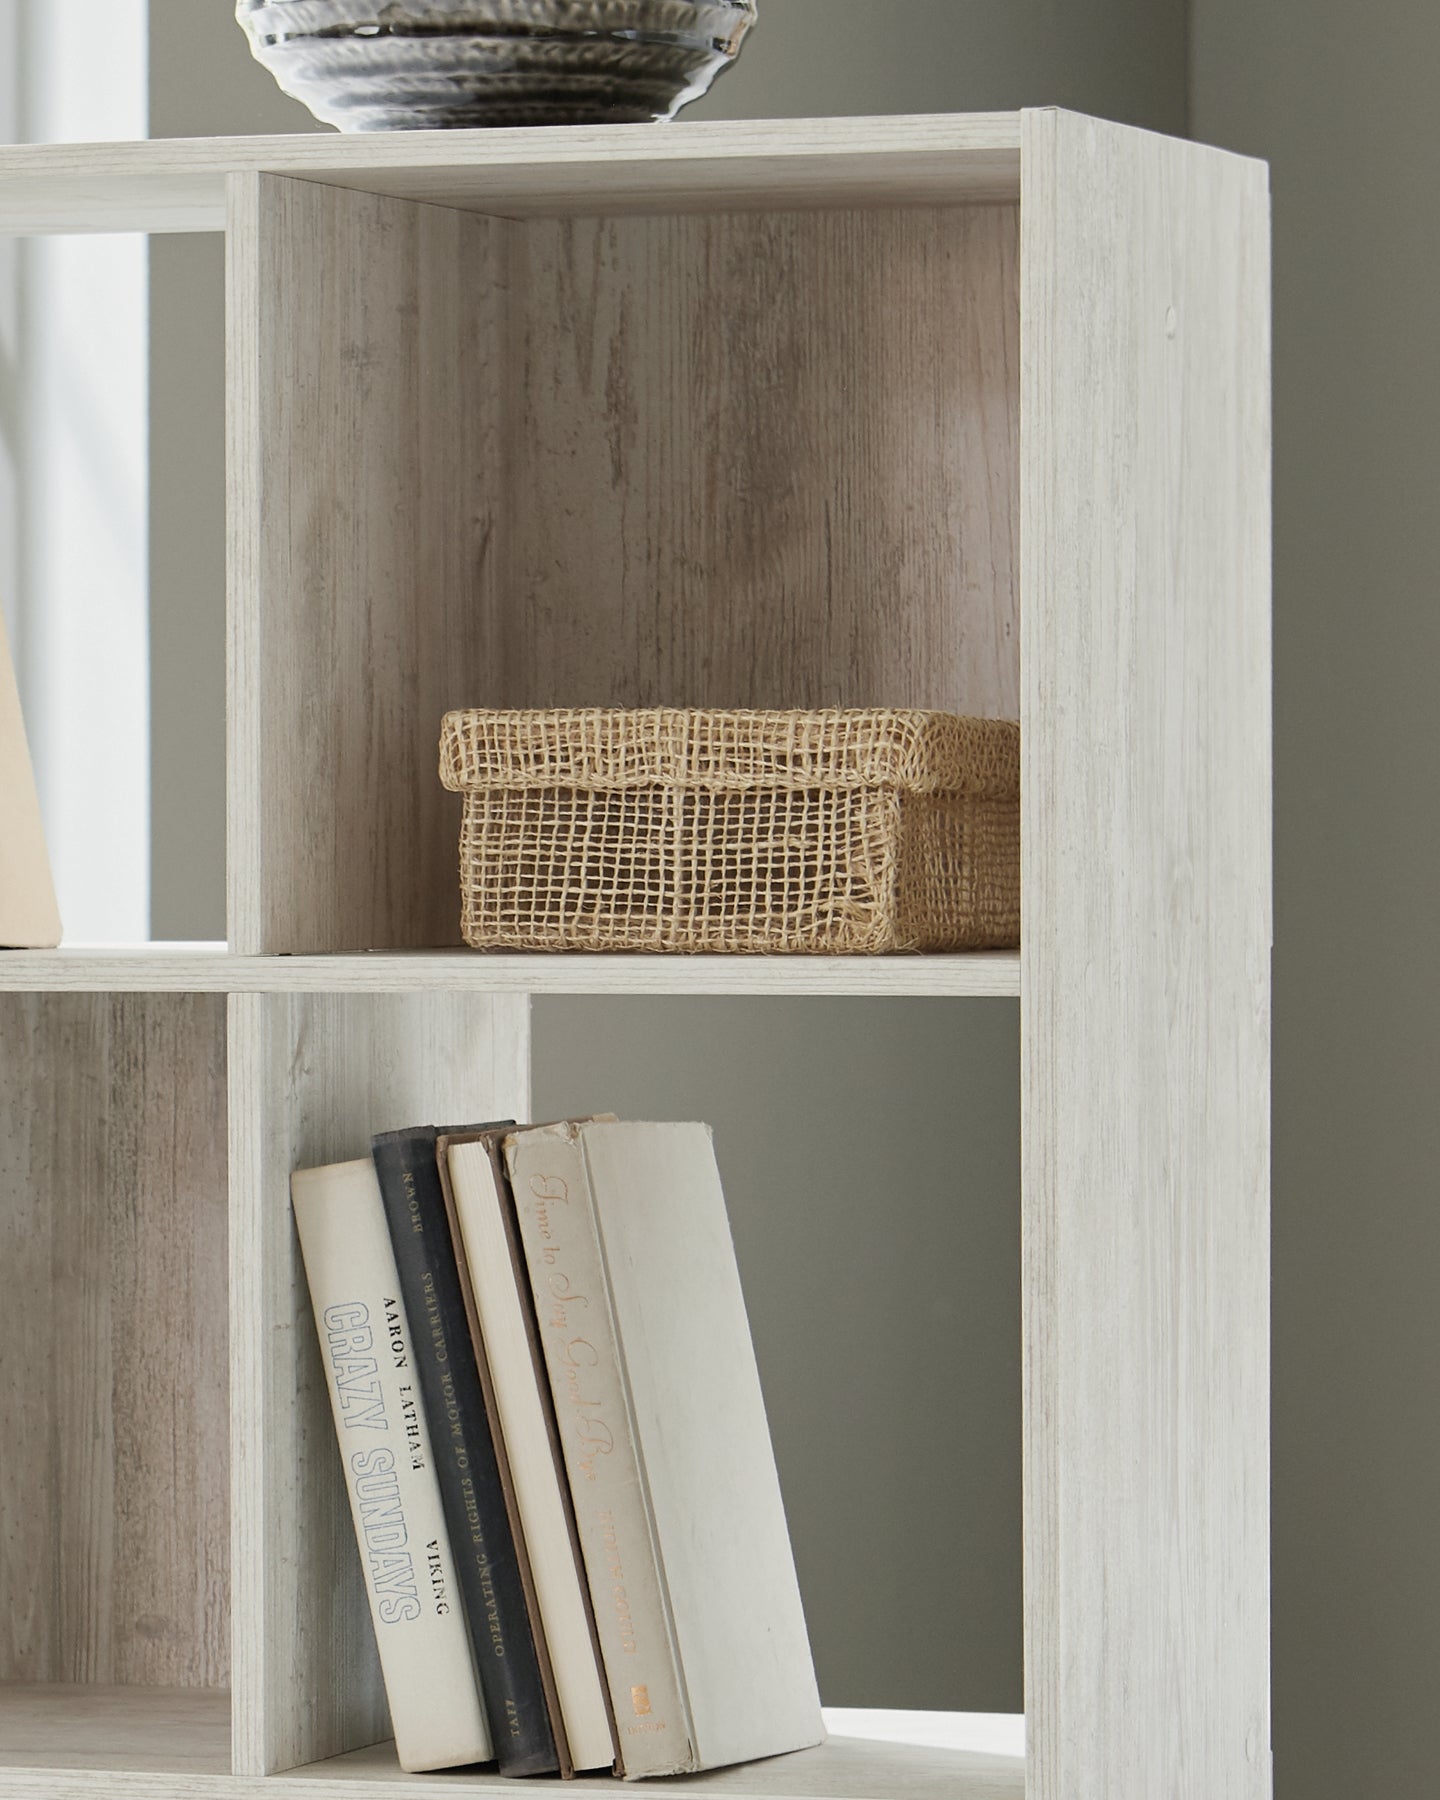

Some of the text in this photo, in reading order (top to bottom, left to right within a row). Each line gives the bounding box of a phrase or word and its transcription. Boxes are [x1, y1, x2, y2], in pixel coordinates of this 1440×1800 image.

[403, 1172, 424, 1234] BROWN
[528, 1173, 569, 1240] Time
[543, 1247, 561, 1266] to
[547, 1272, 589, 1329] Say
[382, 1296, 425, 1471] AARON LATHAM
[323, 1301, 422, 1625] CRAZY SUNDAYS
[421, 1271, 505, 1658] OPERATING RIGHTS OF MOTOR CARRIERS
[425, 1539, 451, 1617] VIKING
